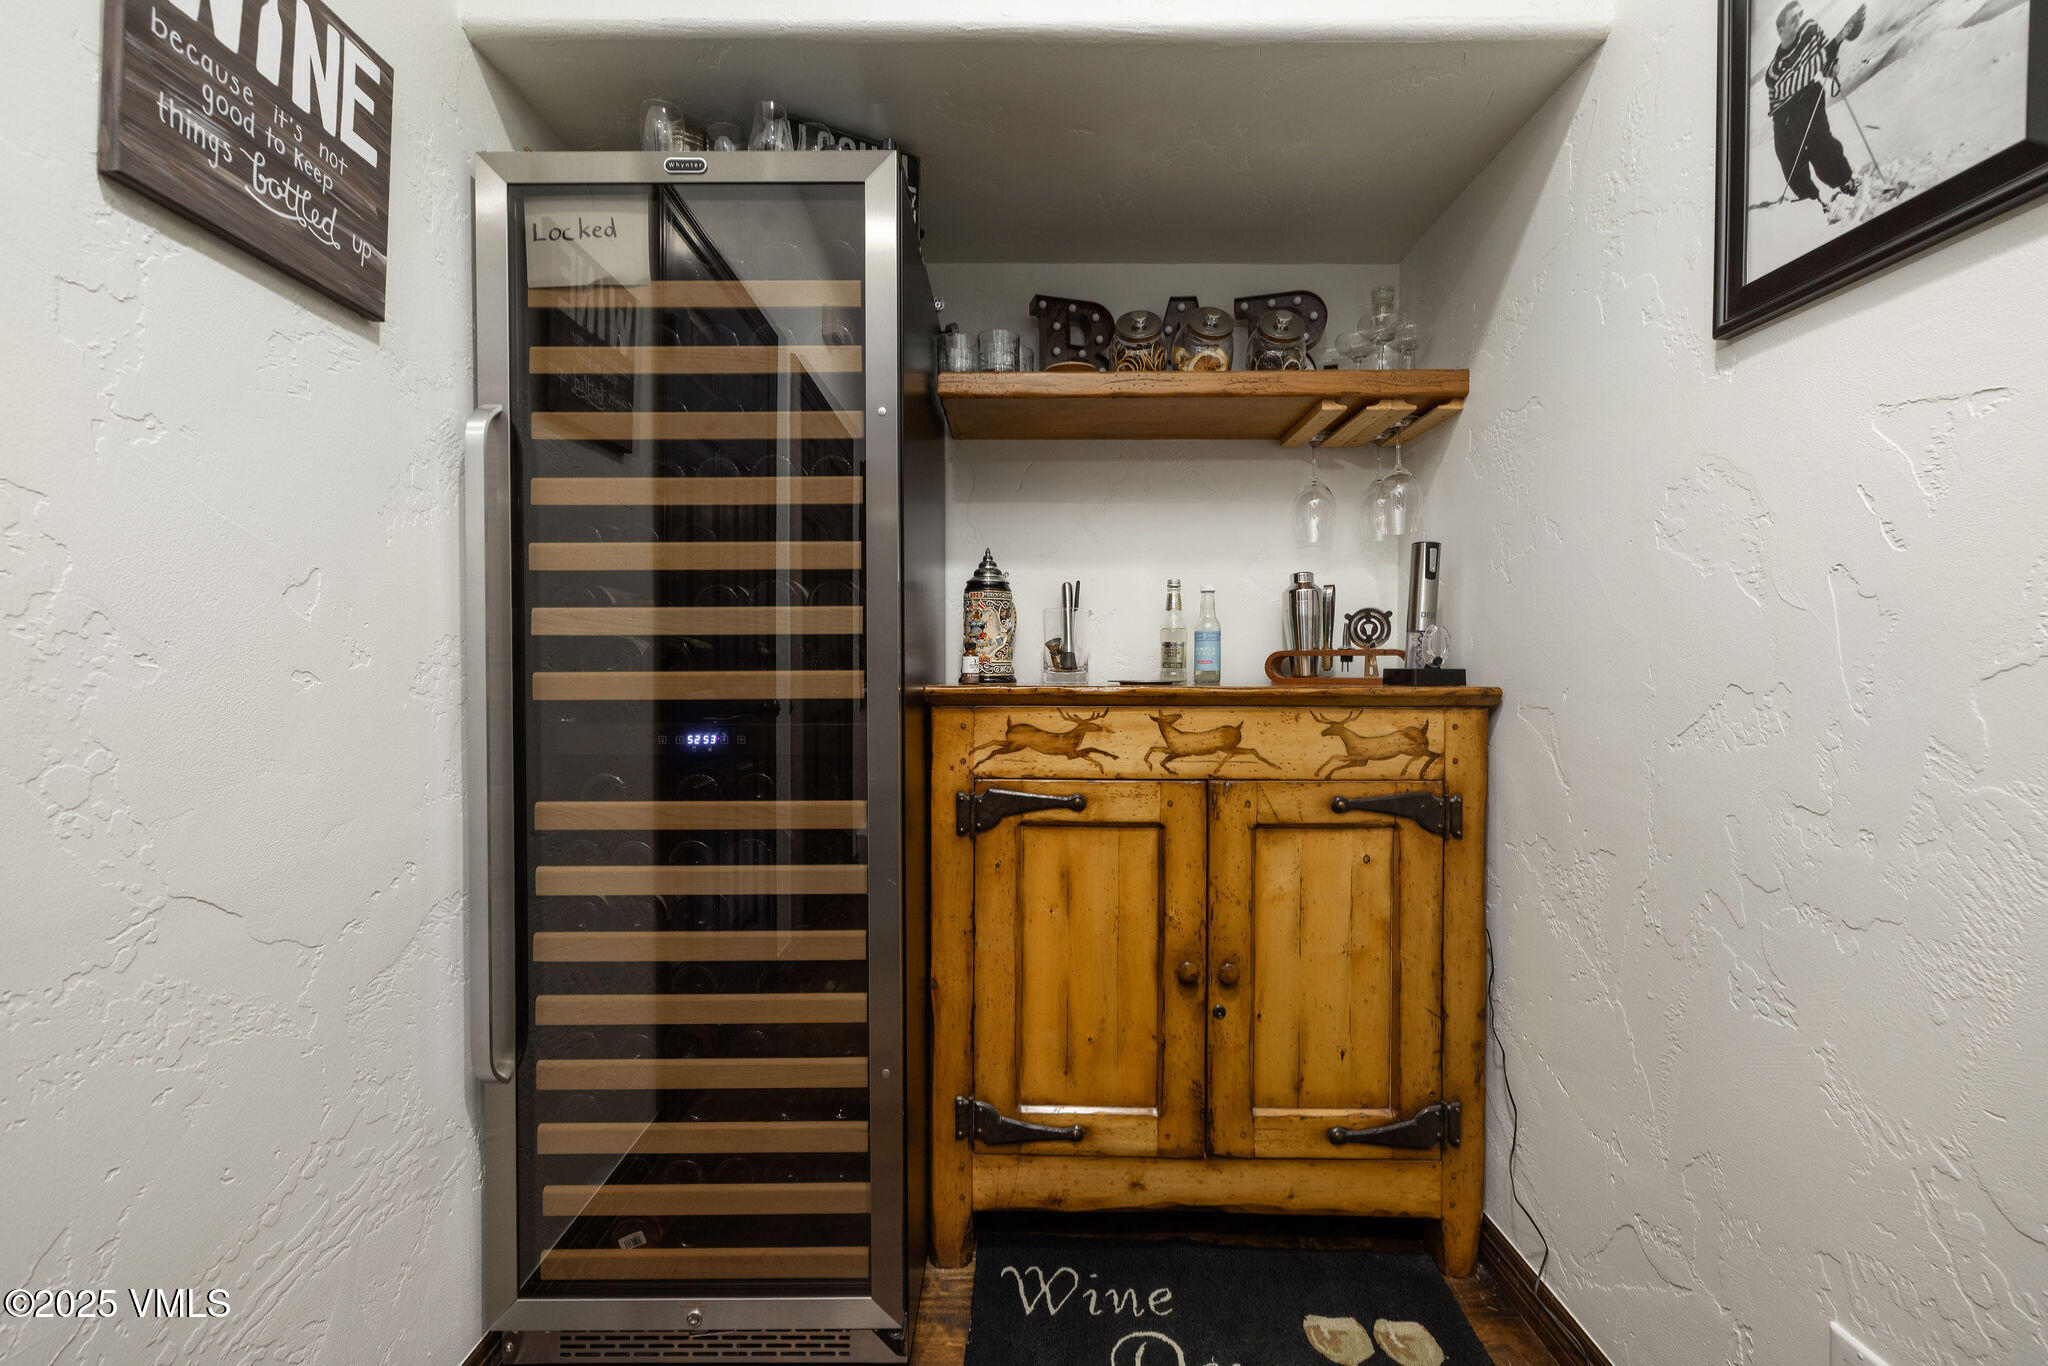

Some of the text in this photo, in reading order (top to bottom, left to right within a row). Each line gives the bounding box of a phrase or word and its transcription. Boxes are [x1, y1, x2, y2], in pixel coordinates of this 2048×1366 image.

[151, 6, 349, 175] because it's not
[202, 83, 255, 138] good
[265, 127, 286, 155] to
[157, 91, 372, 267] things bottled up
[532, 217, 617, 242] Locked
[687, 734, 717, 745] 52 53
[1001, 1266, 1173, 1317] Wine
